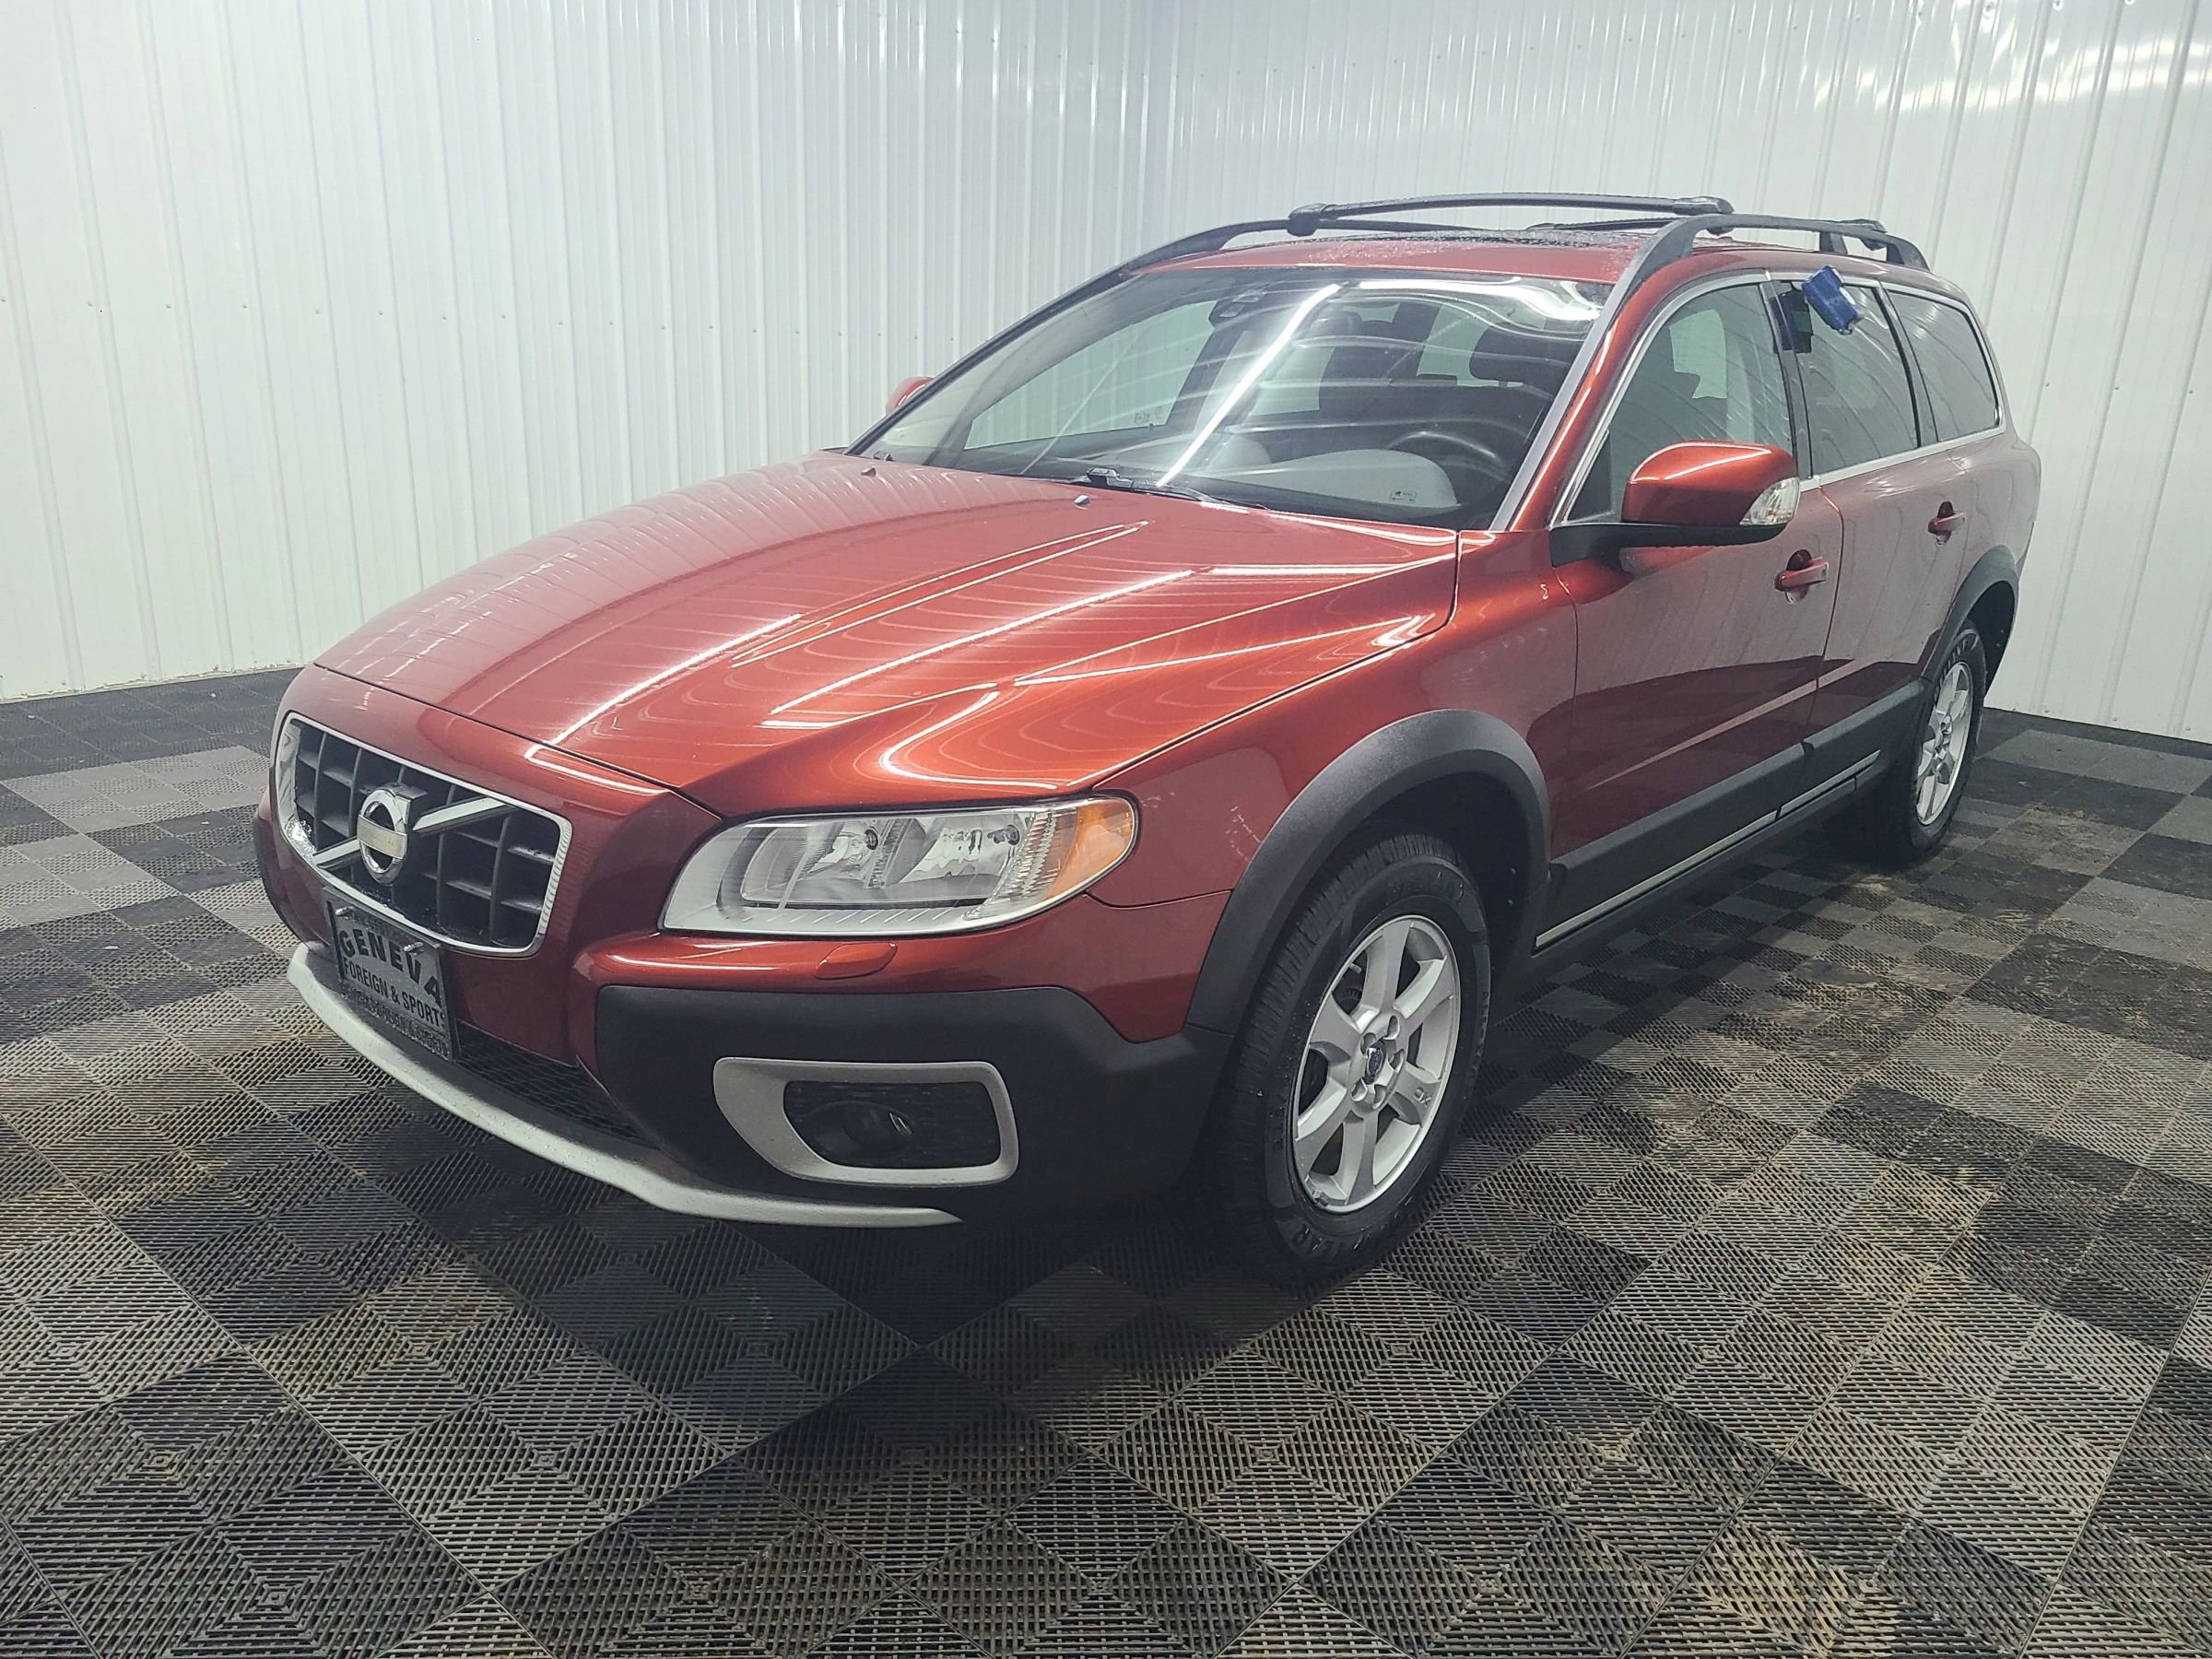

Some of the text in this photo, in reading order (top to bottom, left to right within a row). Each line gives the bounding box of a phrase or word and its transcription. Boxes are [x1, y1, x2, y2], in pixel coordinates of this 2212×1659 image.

[338, 928, 442, 1008] GENEVA
[342, 958, 388, 997] FOREIGN
[392, 985, 400, 1005] &
